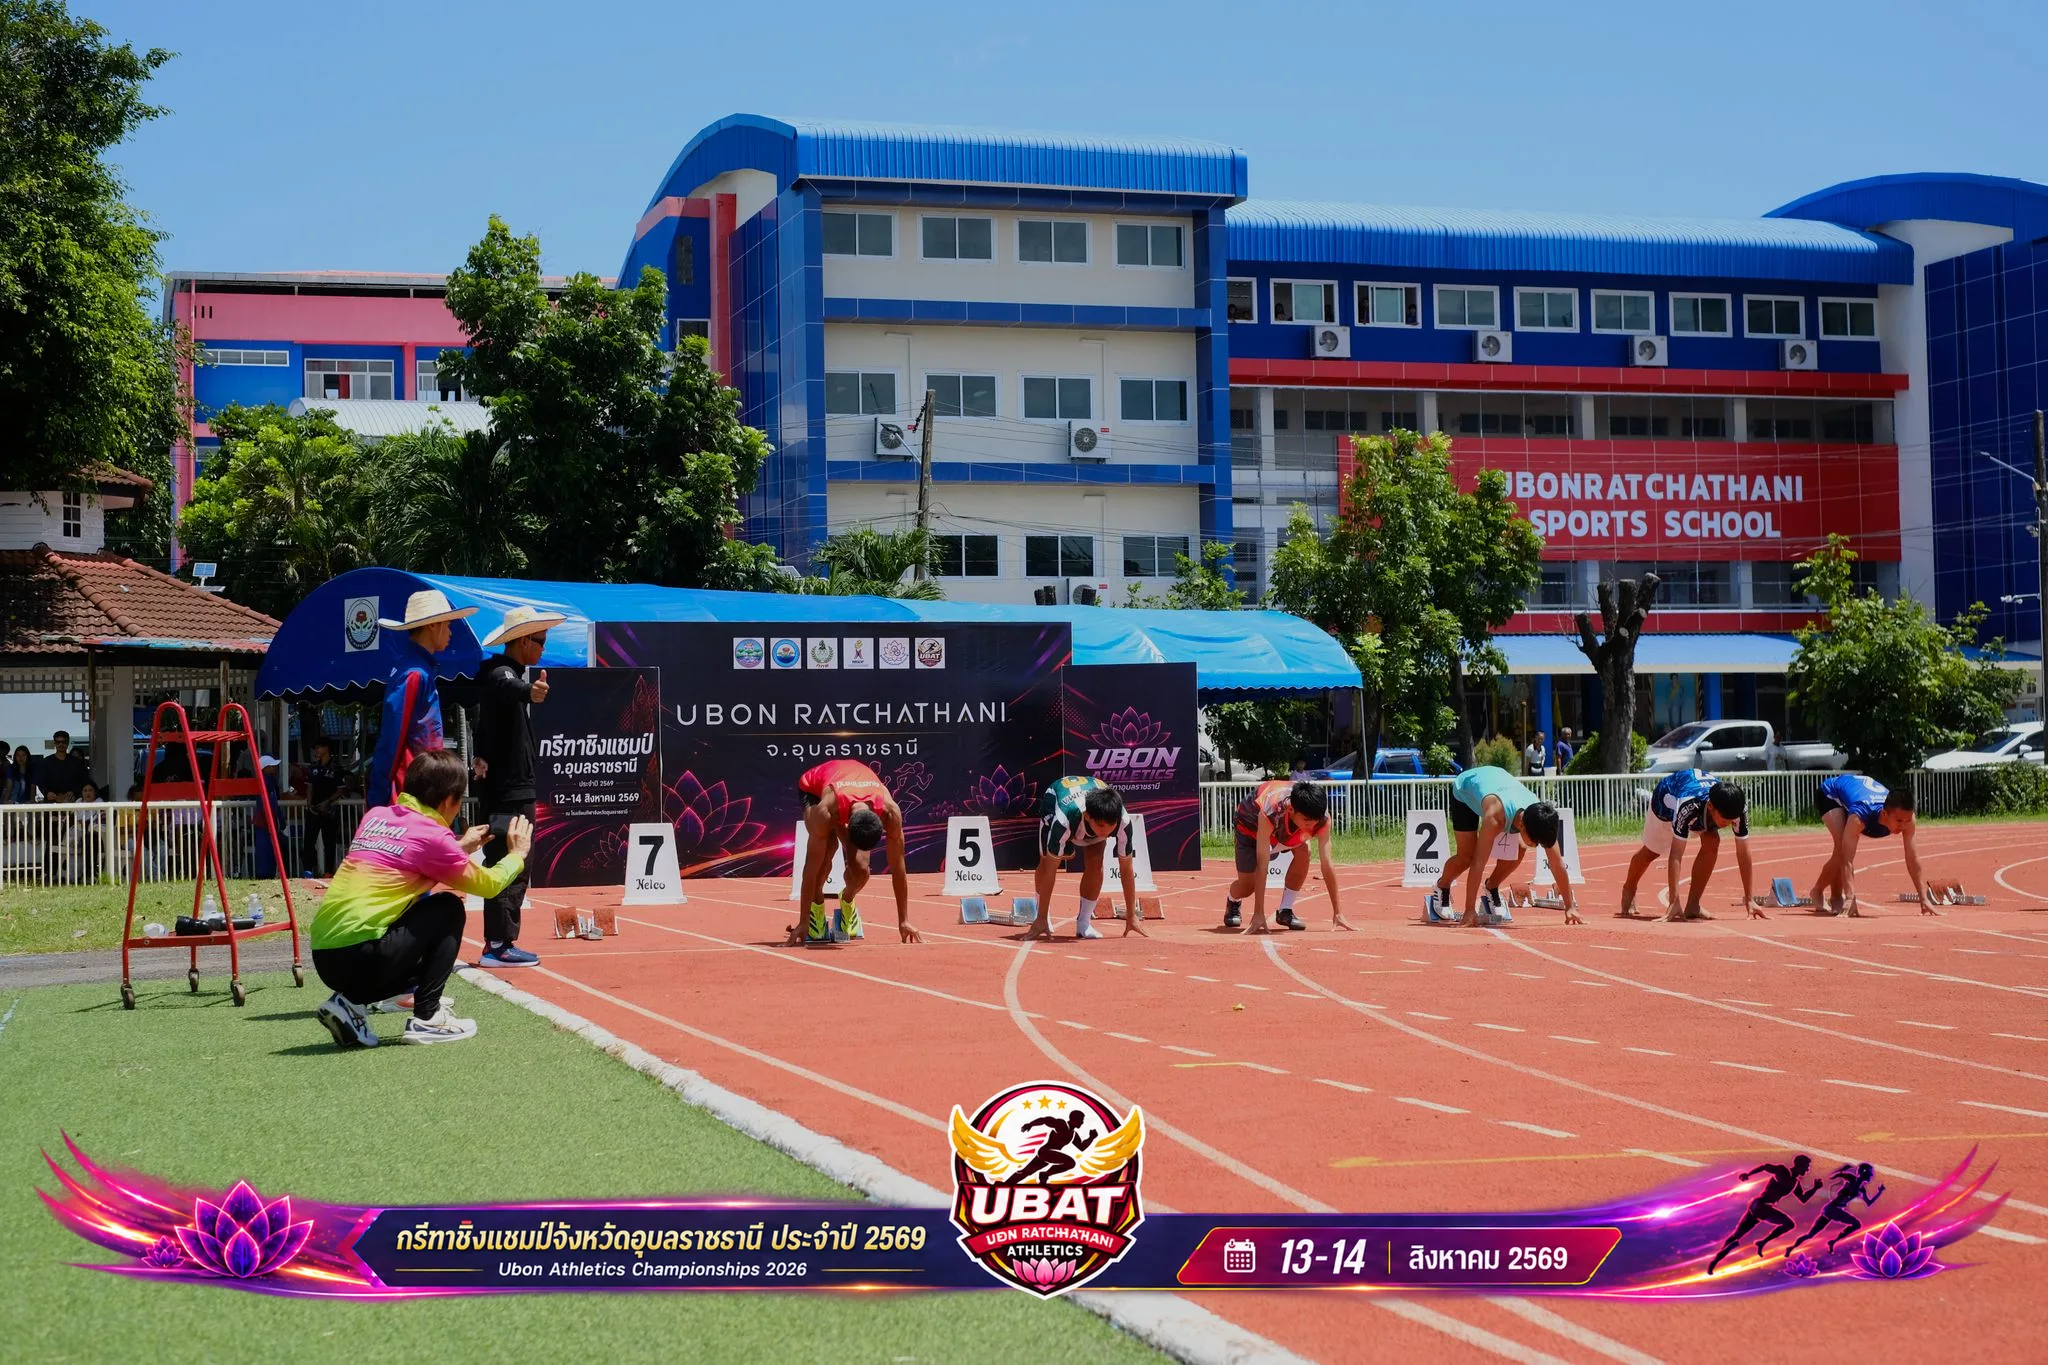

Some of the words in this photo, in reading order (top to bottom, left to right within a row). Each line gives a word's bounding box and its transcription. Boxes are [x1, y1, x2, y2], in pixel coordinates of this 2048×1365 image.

[1530, 509, 1647, 537] SPORTS
[1665, 510, 1781, 539] SCHOOL
[676, 703, 777, 726] UBON
[794, 701, 1006, 725] RATCHATHANI
[766, 737, 918, 763] จ.อุบลราชธานี
[1085, 746, 1182, 770] UBON
[553, 757, 638, 778] จ.อุบลราชธานี
[1092, 768, 1177, 781] ATHLETICS
[584, 793, 616, 804] สิงหาคม
[618, 792, 640, 802] 2569
[958, 828, 981, 868] 5
[1415, 822, 1439, 860] 2
[1498, 832, 1511, 852] 4
[639, 835, 665, 876] 7
[954, 870, 983, 882] Nelco
[1412, 863, 1440, 874] Nelco
[635, 878, 666, 890] Nelco
